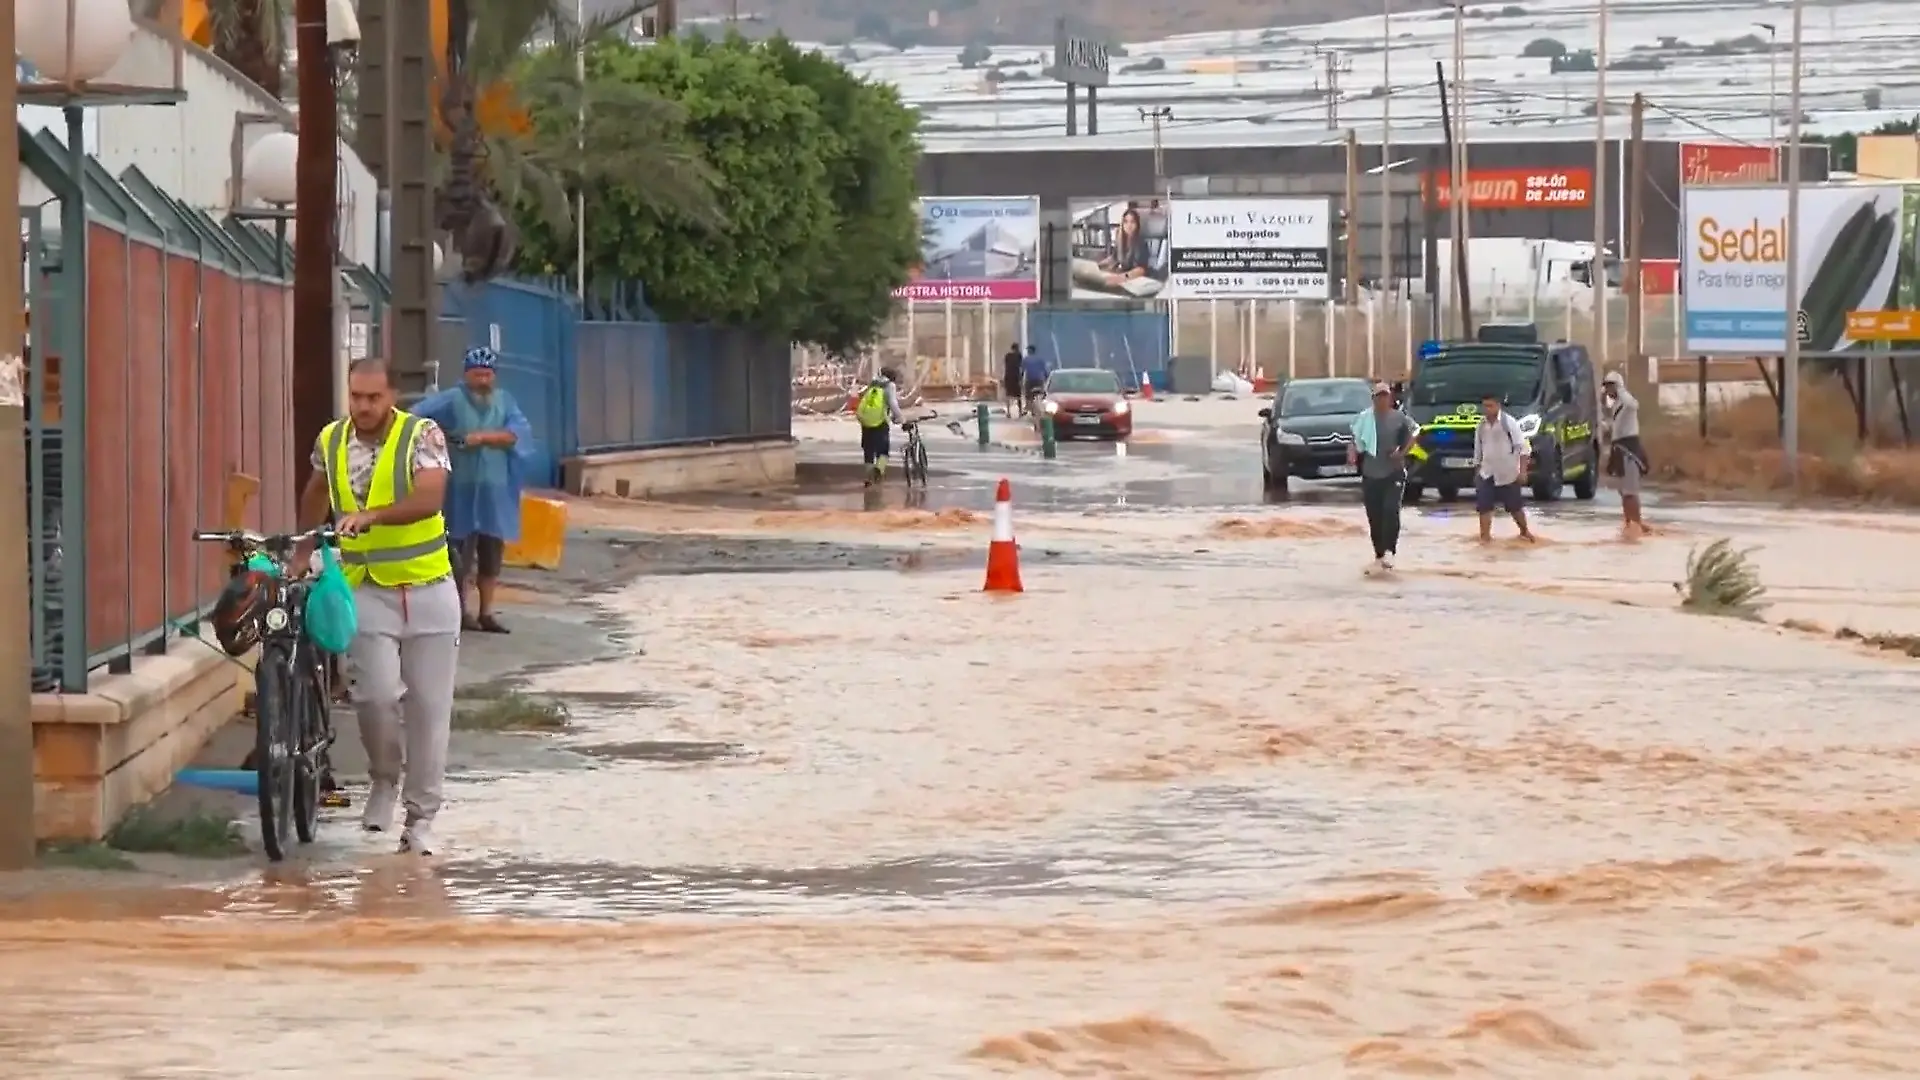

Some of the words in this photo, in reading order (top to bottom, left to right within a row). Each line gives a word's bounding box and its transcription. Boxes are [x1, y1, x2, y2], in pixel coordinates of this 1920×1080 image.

[1226, 229, 1281, 240] abogados
[1698, 217, 1787, 263] Sedal
[940, 286, 993, 298] HISTORIA
